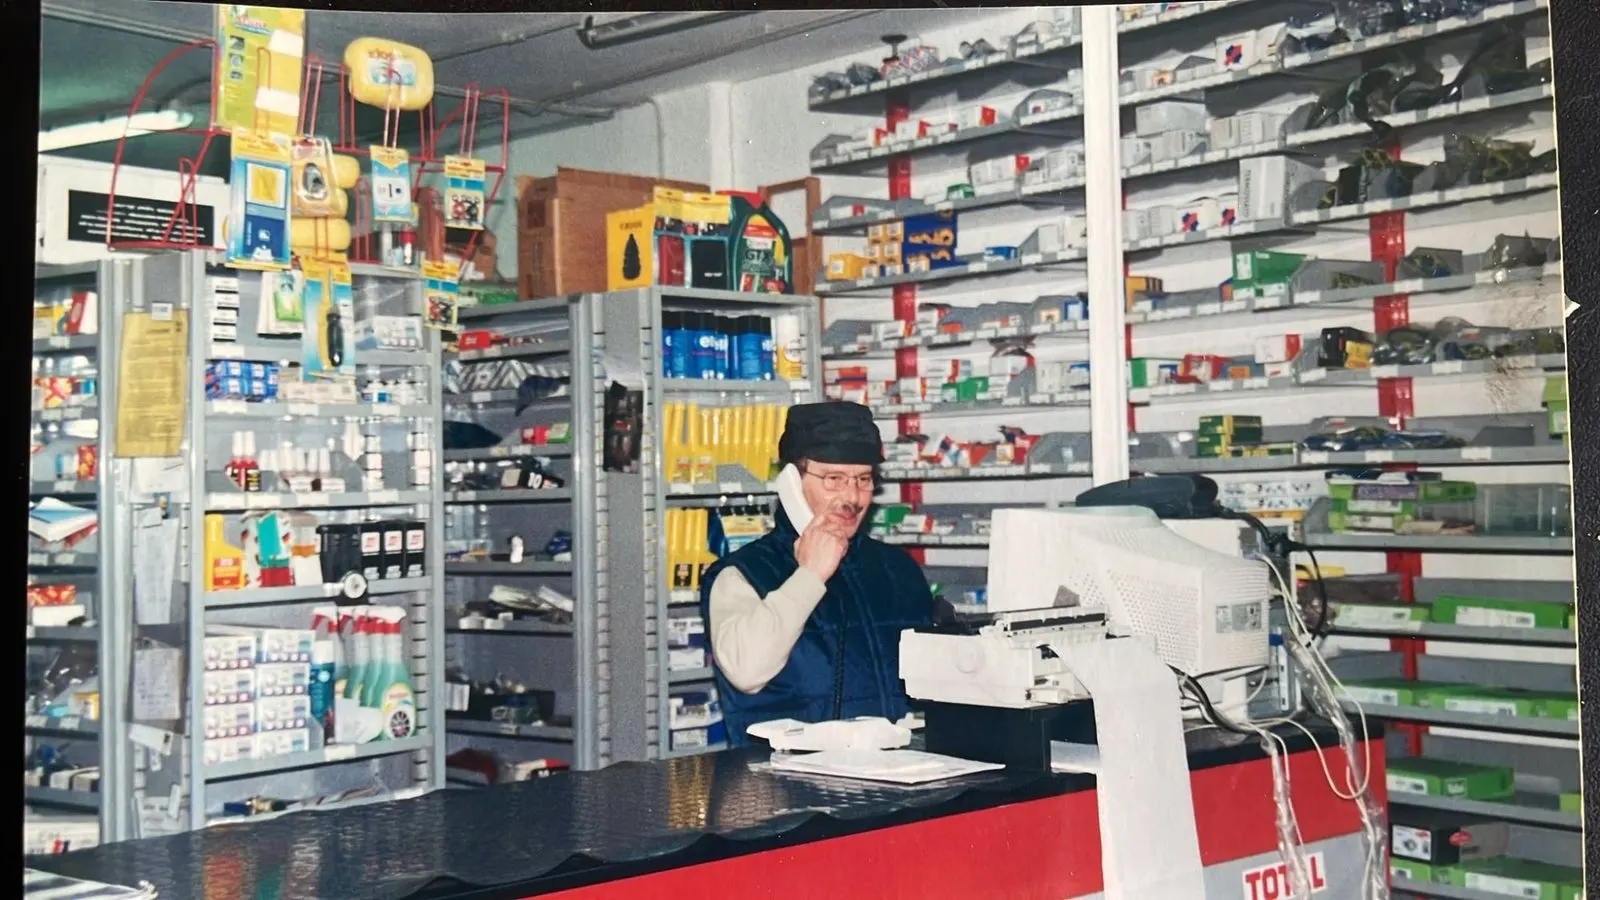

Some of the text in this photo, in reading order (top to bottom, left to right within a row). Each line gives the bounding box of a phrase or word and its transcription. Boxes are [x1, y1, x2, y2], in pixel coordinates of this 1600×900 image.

[745, 249, 770, 262] GTX
[527, 471, 543, 489] 10
[1245, 856, 1324, 900] TOTL
